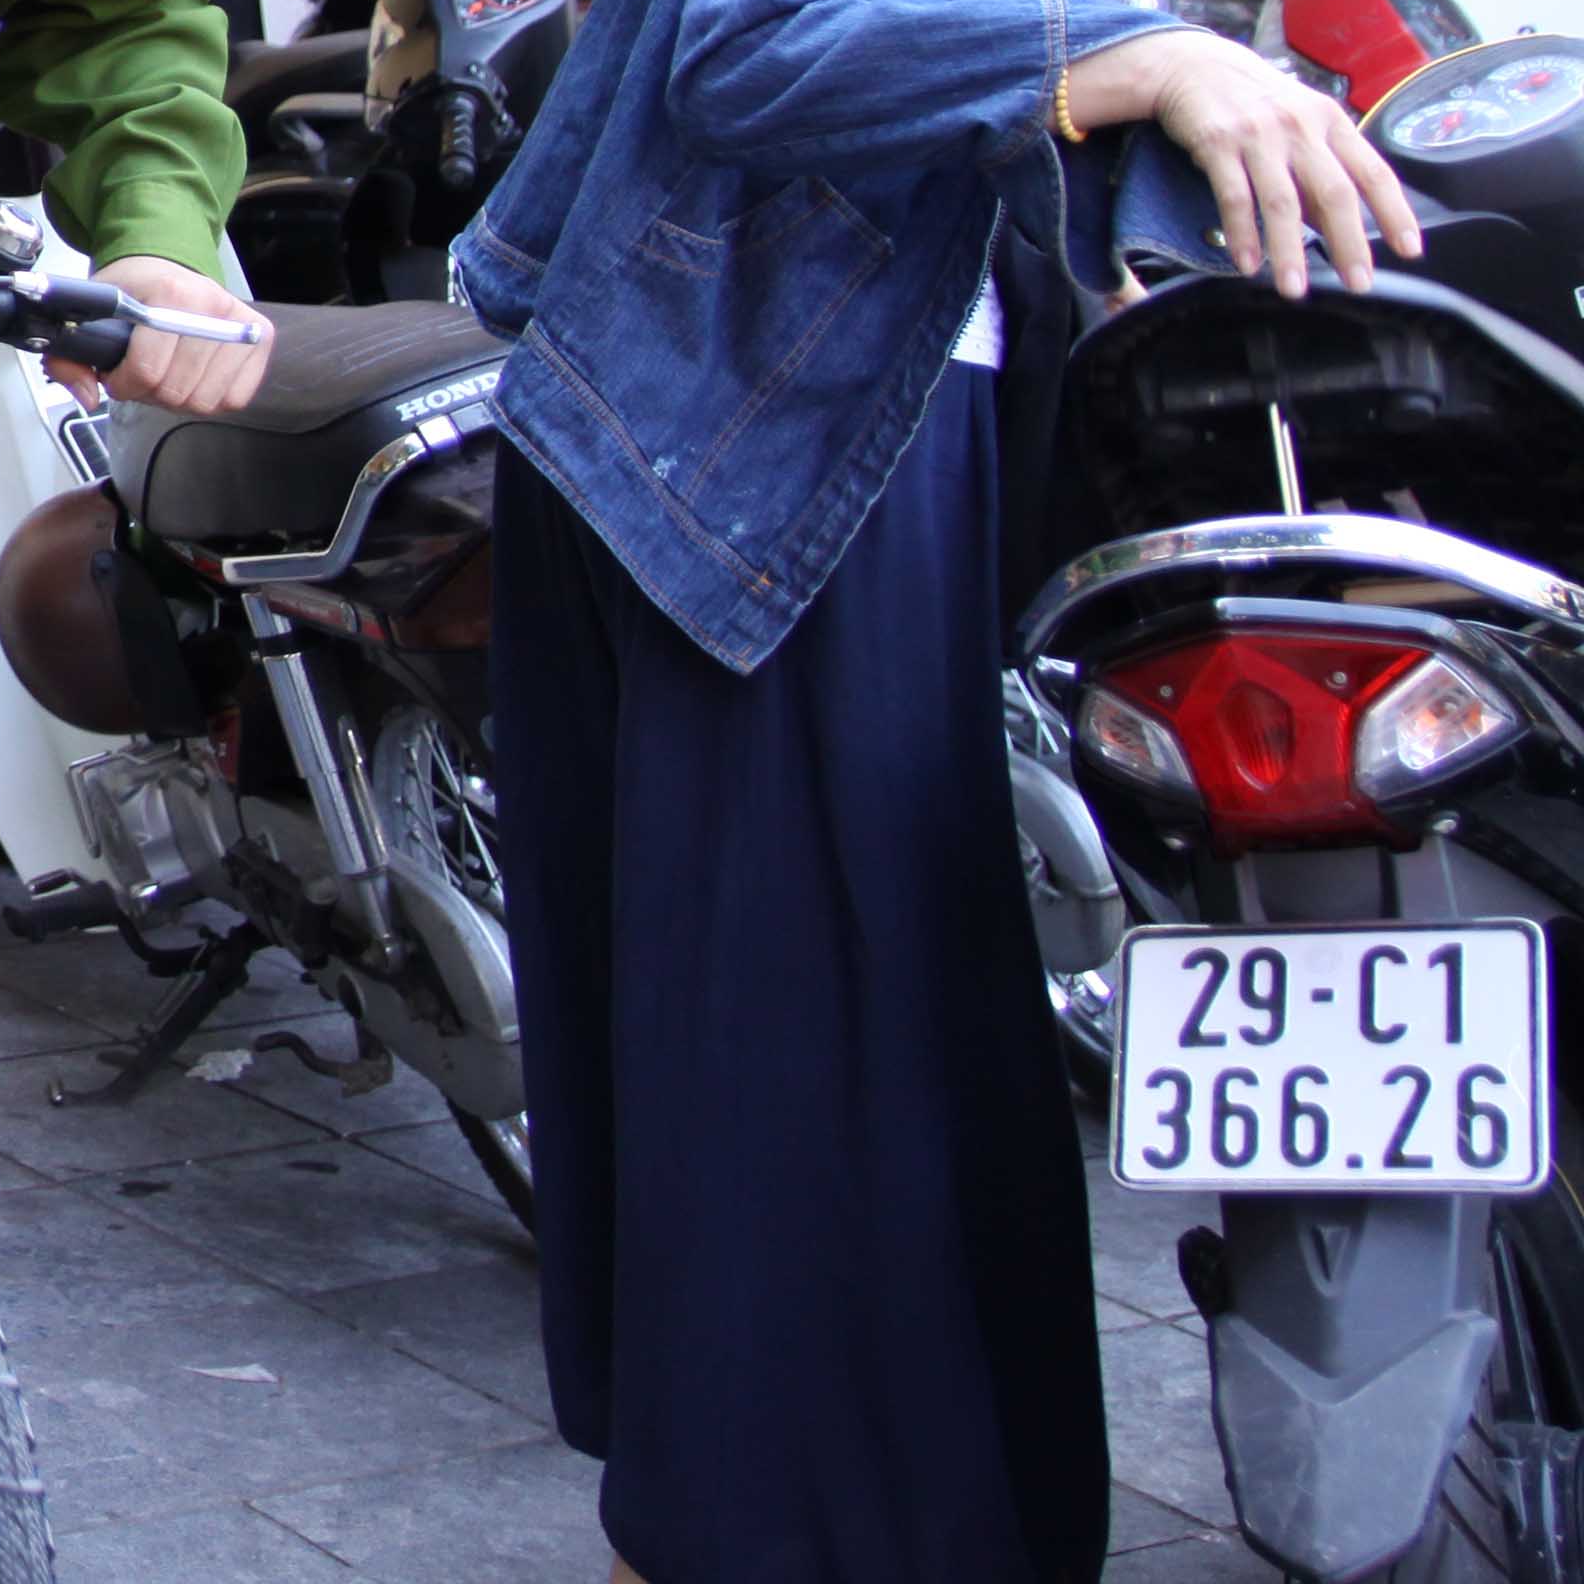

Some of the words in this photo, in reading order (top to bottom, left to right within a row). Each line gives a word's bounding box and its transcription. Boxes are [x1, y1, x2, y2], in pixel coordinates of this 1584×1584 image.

[394, 371, 502, 423] HOND
[1177, 942, 1464, 1049] 29-C1
[1141, 1063, 1509, 1171] 366.26
